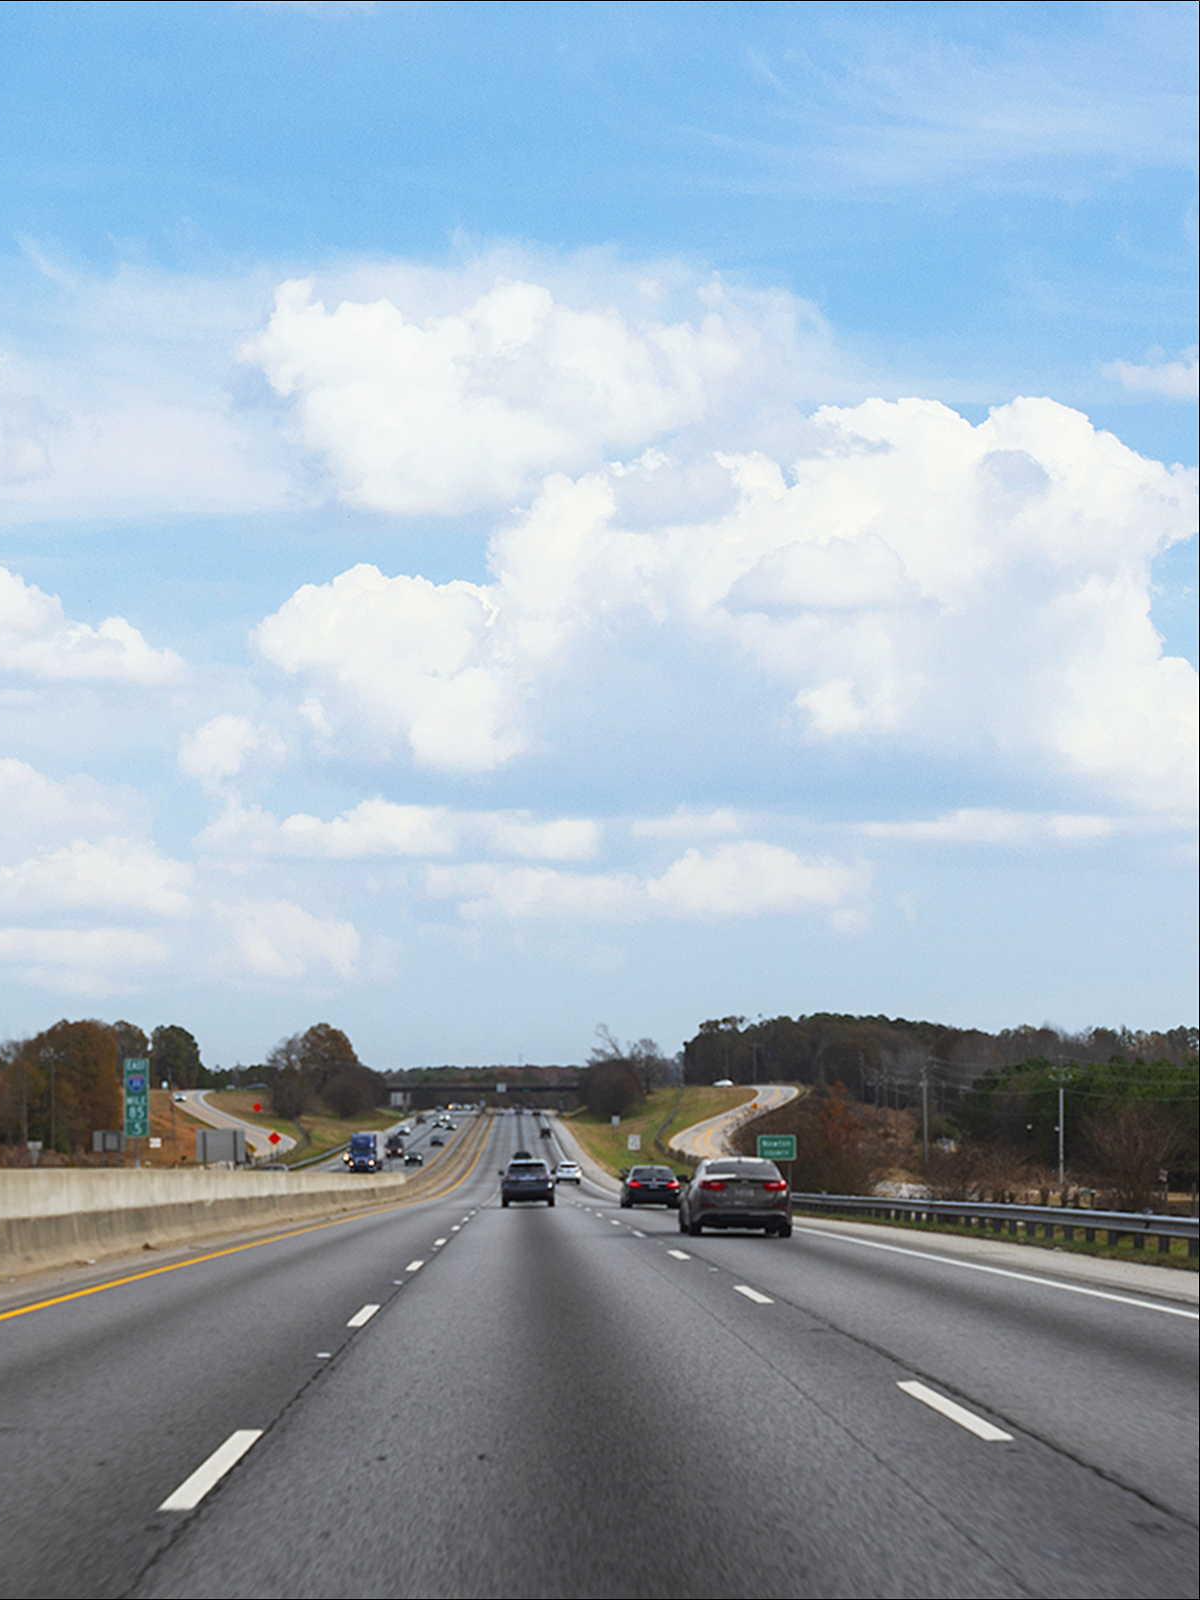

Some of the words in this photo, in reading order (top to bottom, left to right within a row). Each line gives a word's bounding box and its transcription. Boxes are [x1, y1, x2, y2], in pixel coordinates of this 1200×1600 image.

[126, 1059, 146, 1071] EAST
[125, 1096, 147, 1106] MILE
[128, 1106, 145, 1119] 85
[132, 1122, 143, 1135] 5
